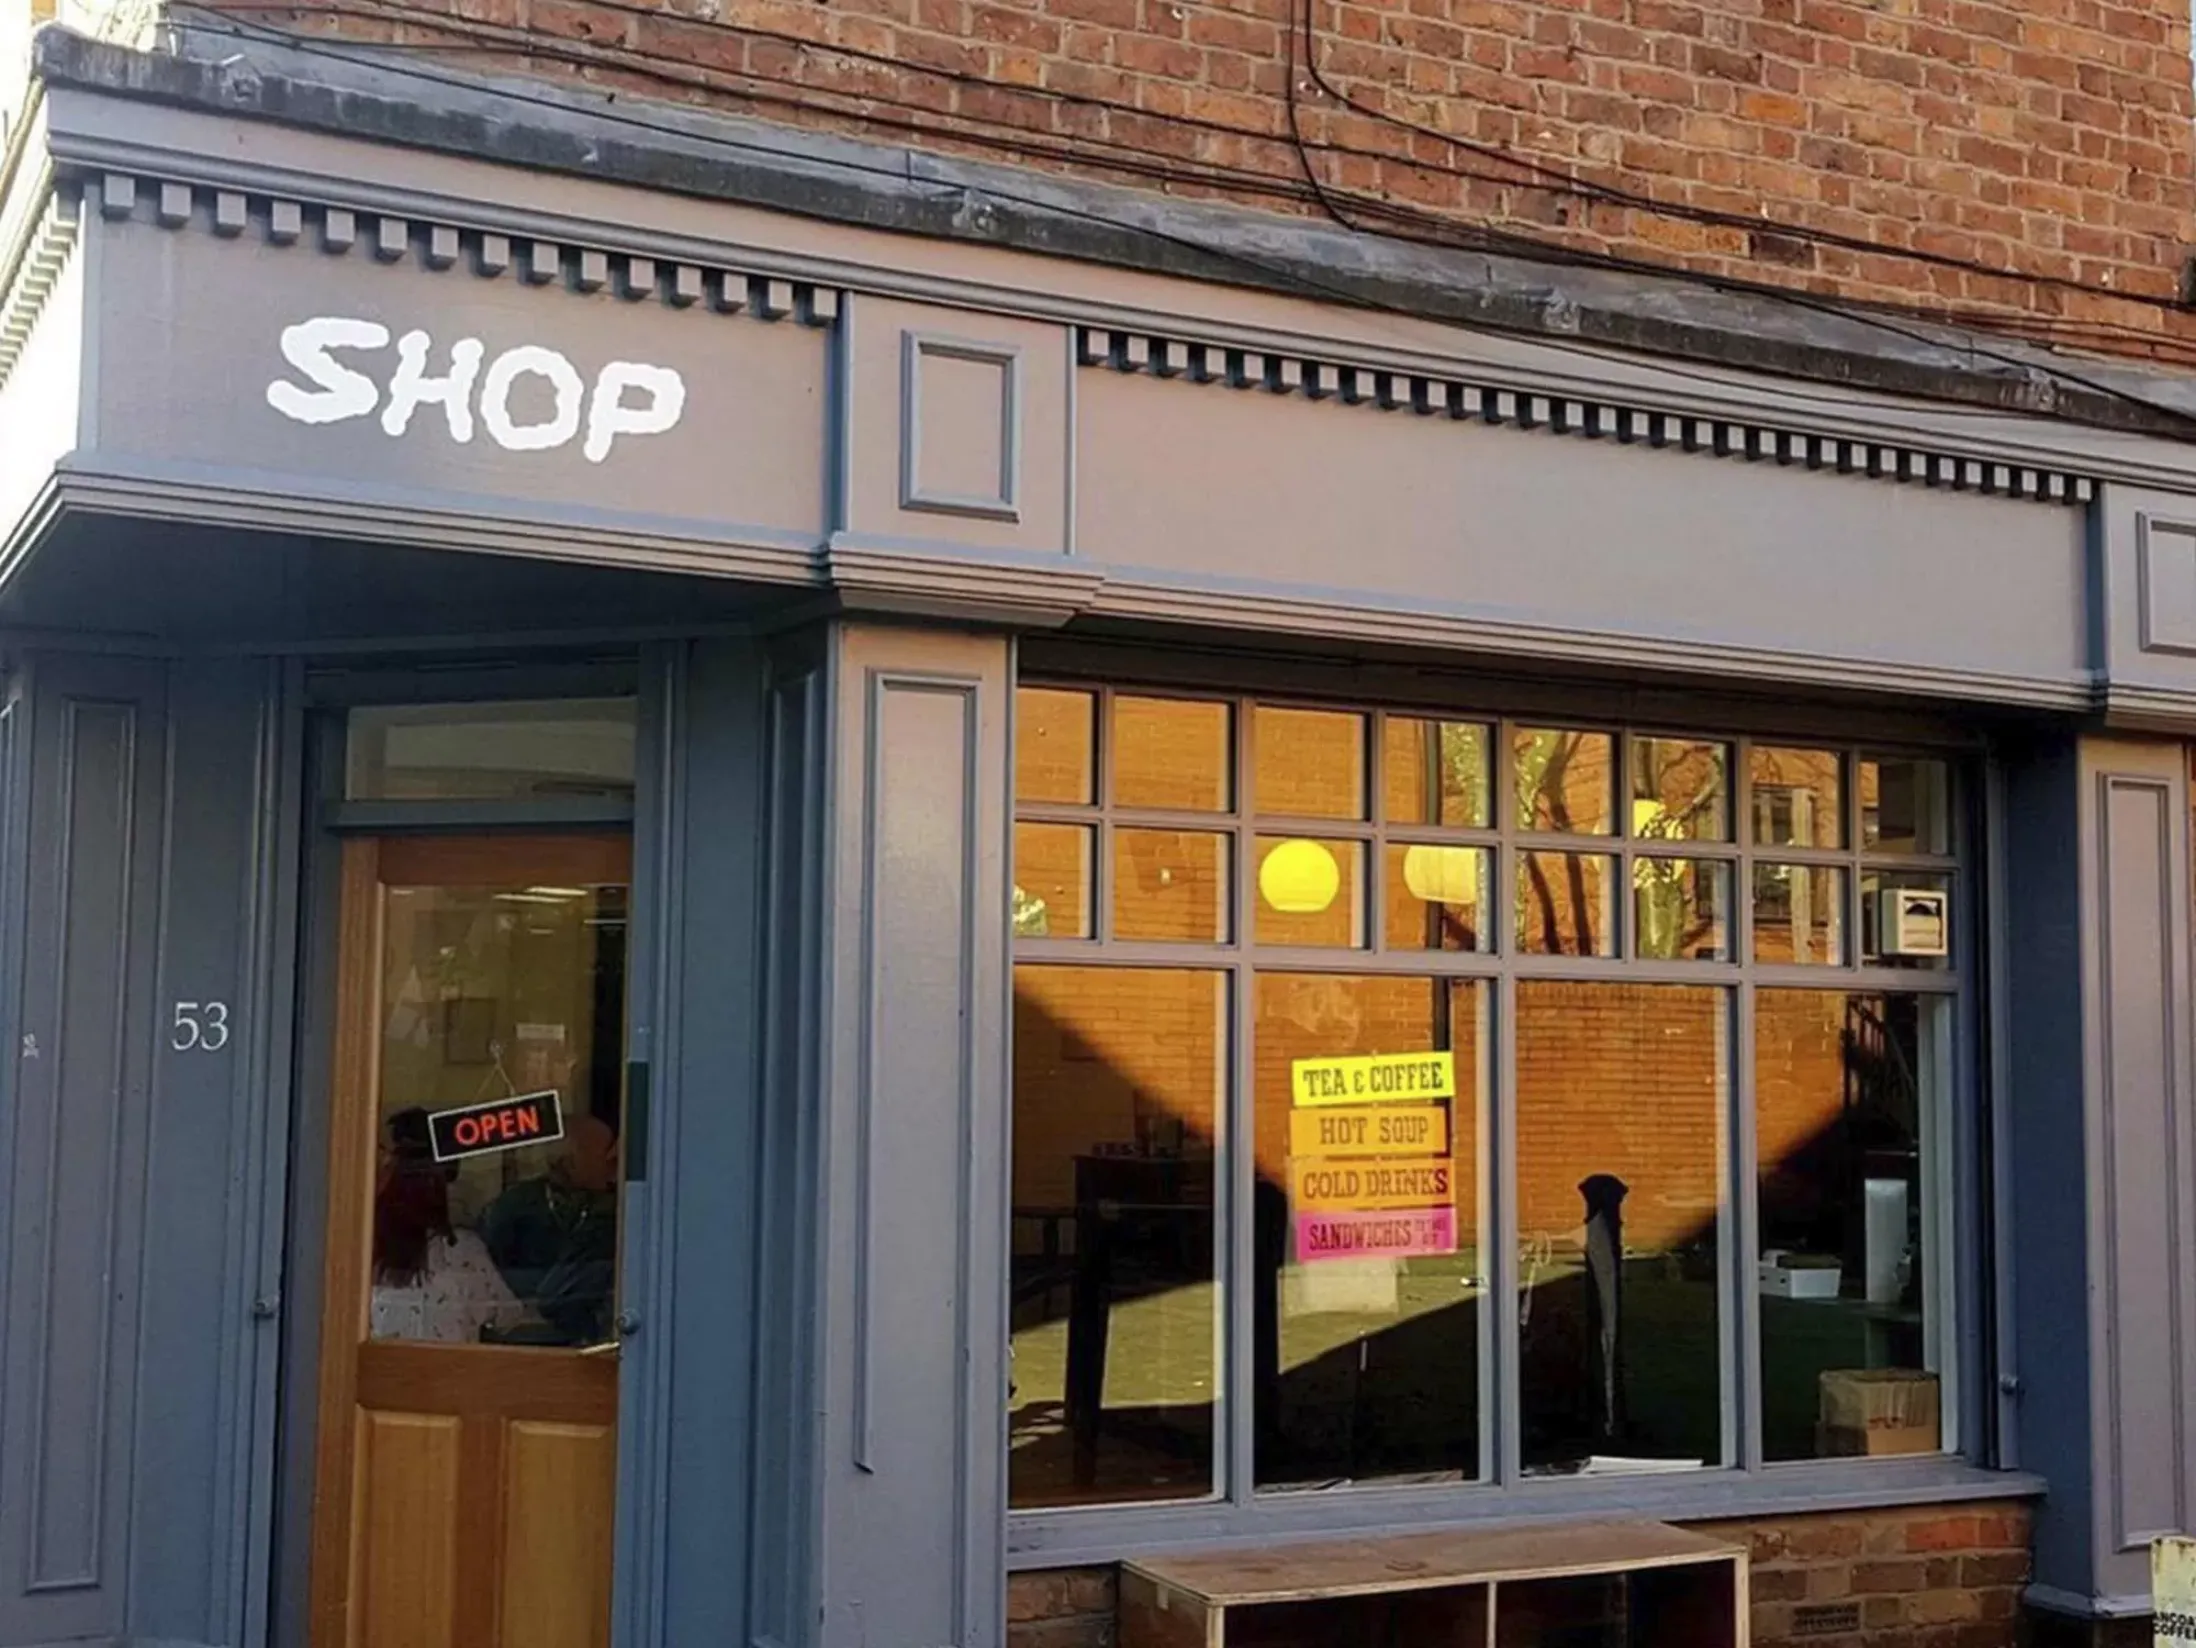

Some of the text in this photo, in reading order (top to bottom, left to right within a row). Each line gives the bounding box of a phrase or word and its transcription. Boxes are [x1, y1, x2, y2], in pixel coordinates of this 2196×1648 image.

[266, 316, 686, 463] SHOP
[171, 1001, 229, 1051] 53
[1303, 1068, 1347, 1098] TEA
[1370, 1061, 1443, 1093] COFFEE
[455, 1105, 539, 1146] OPEN
[1319, 1116, 1429, 1145] HOT SOUP
[1303, 1168, 1448, 1199] COLD DRINKS
